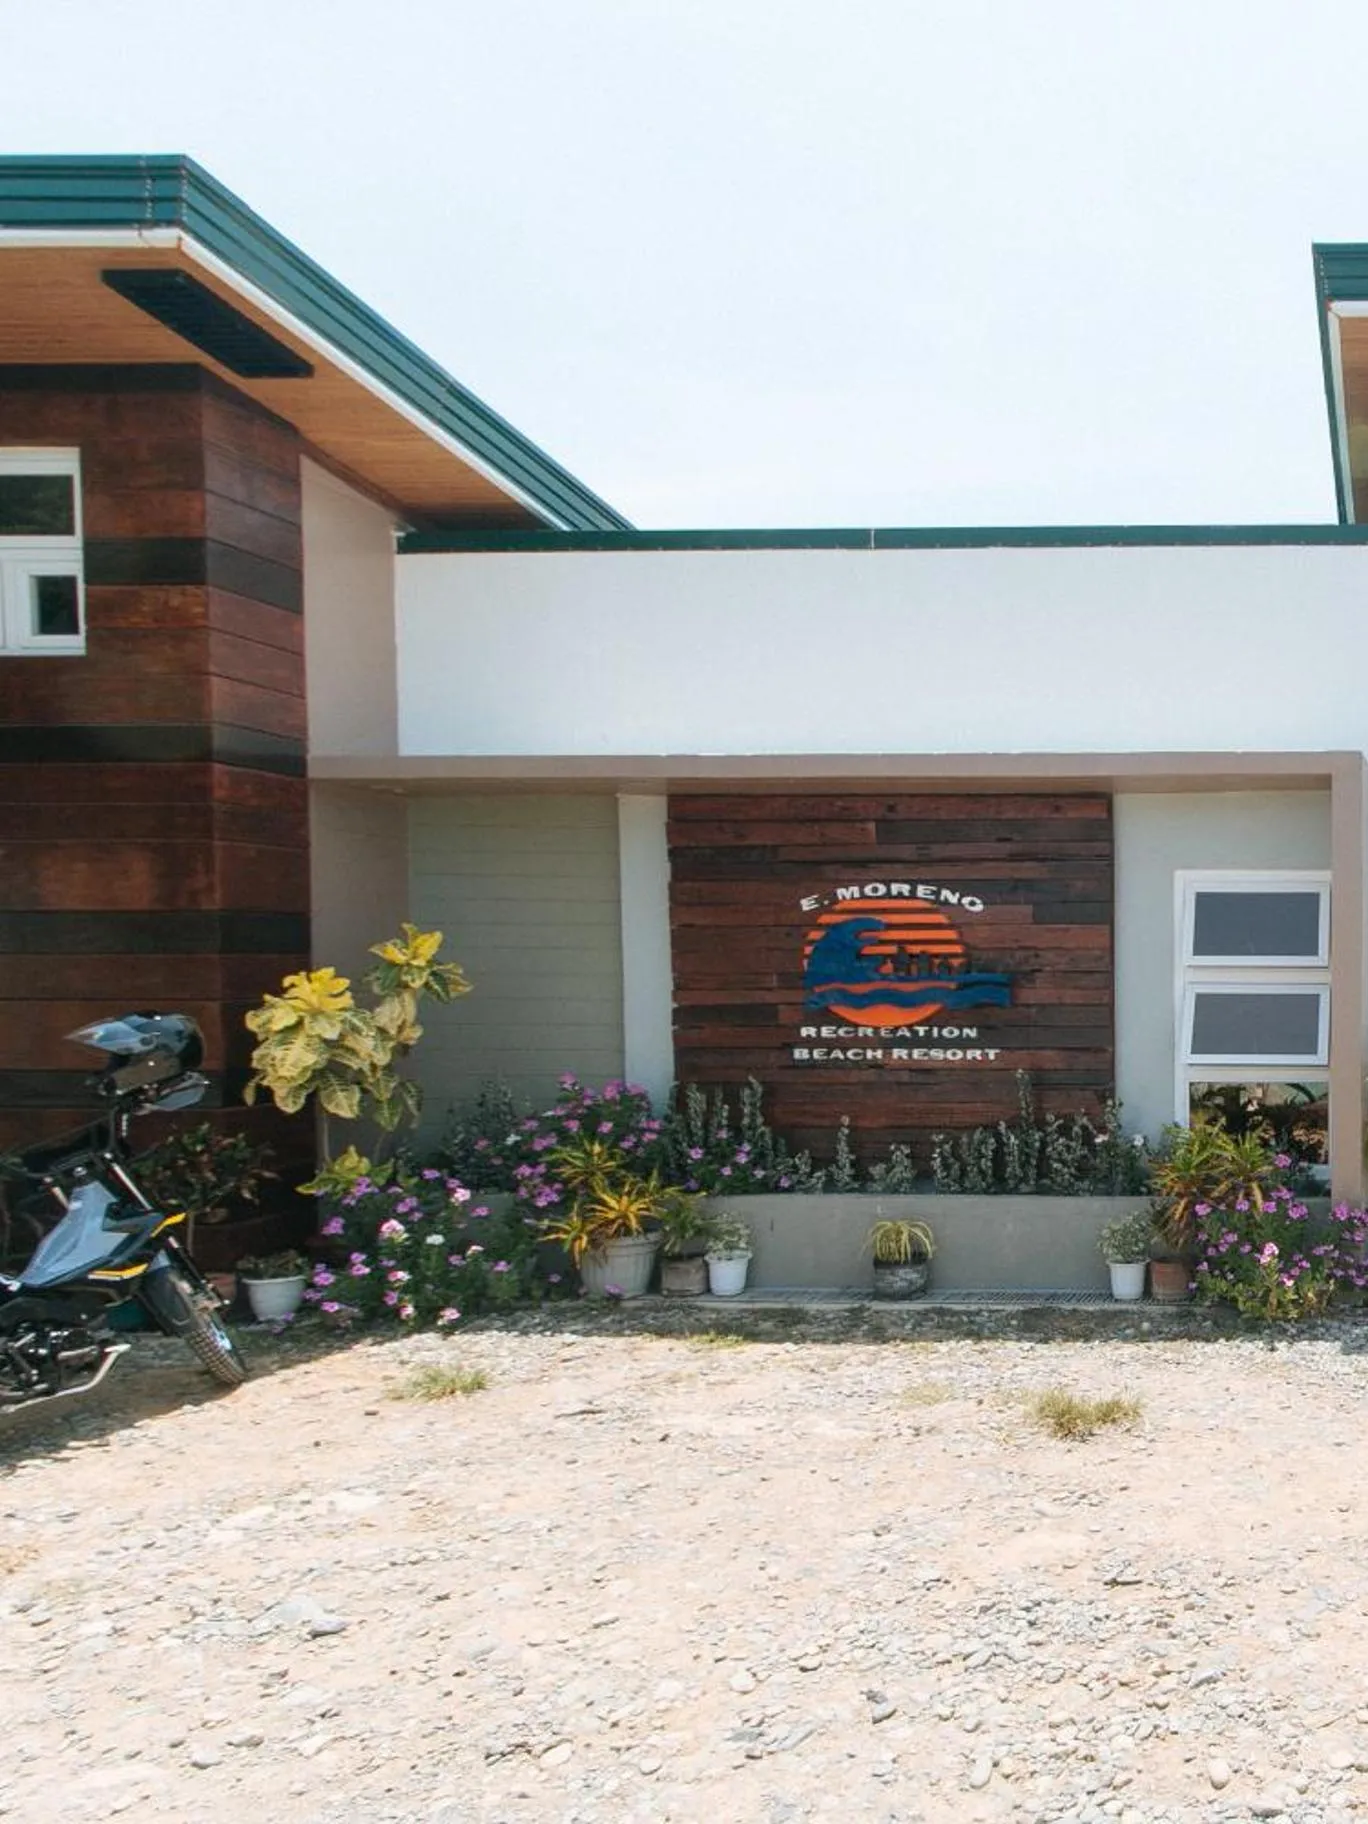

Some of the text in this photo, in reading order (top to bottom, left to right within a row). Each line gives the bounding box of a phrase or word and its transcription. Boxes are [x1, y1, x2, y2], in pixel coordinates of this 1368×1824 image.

[799, 883, 985, 912] E. MORENO
[800, 1026, 978, 1038] RECREATION
[793, 1048, 1001, 1061] BEACH RESORT
